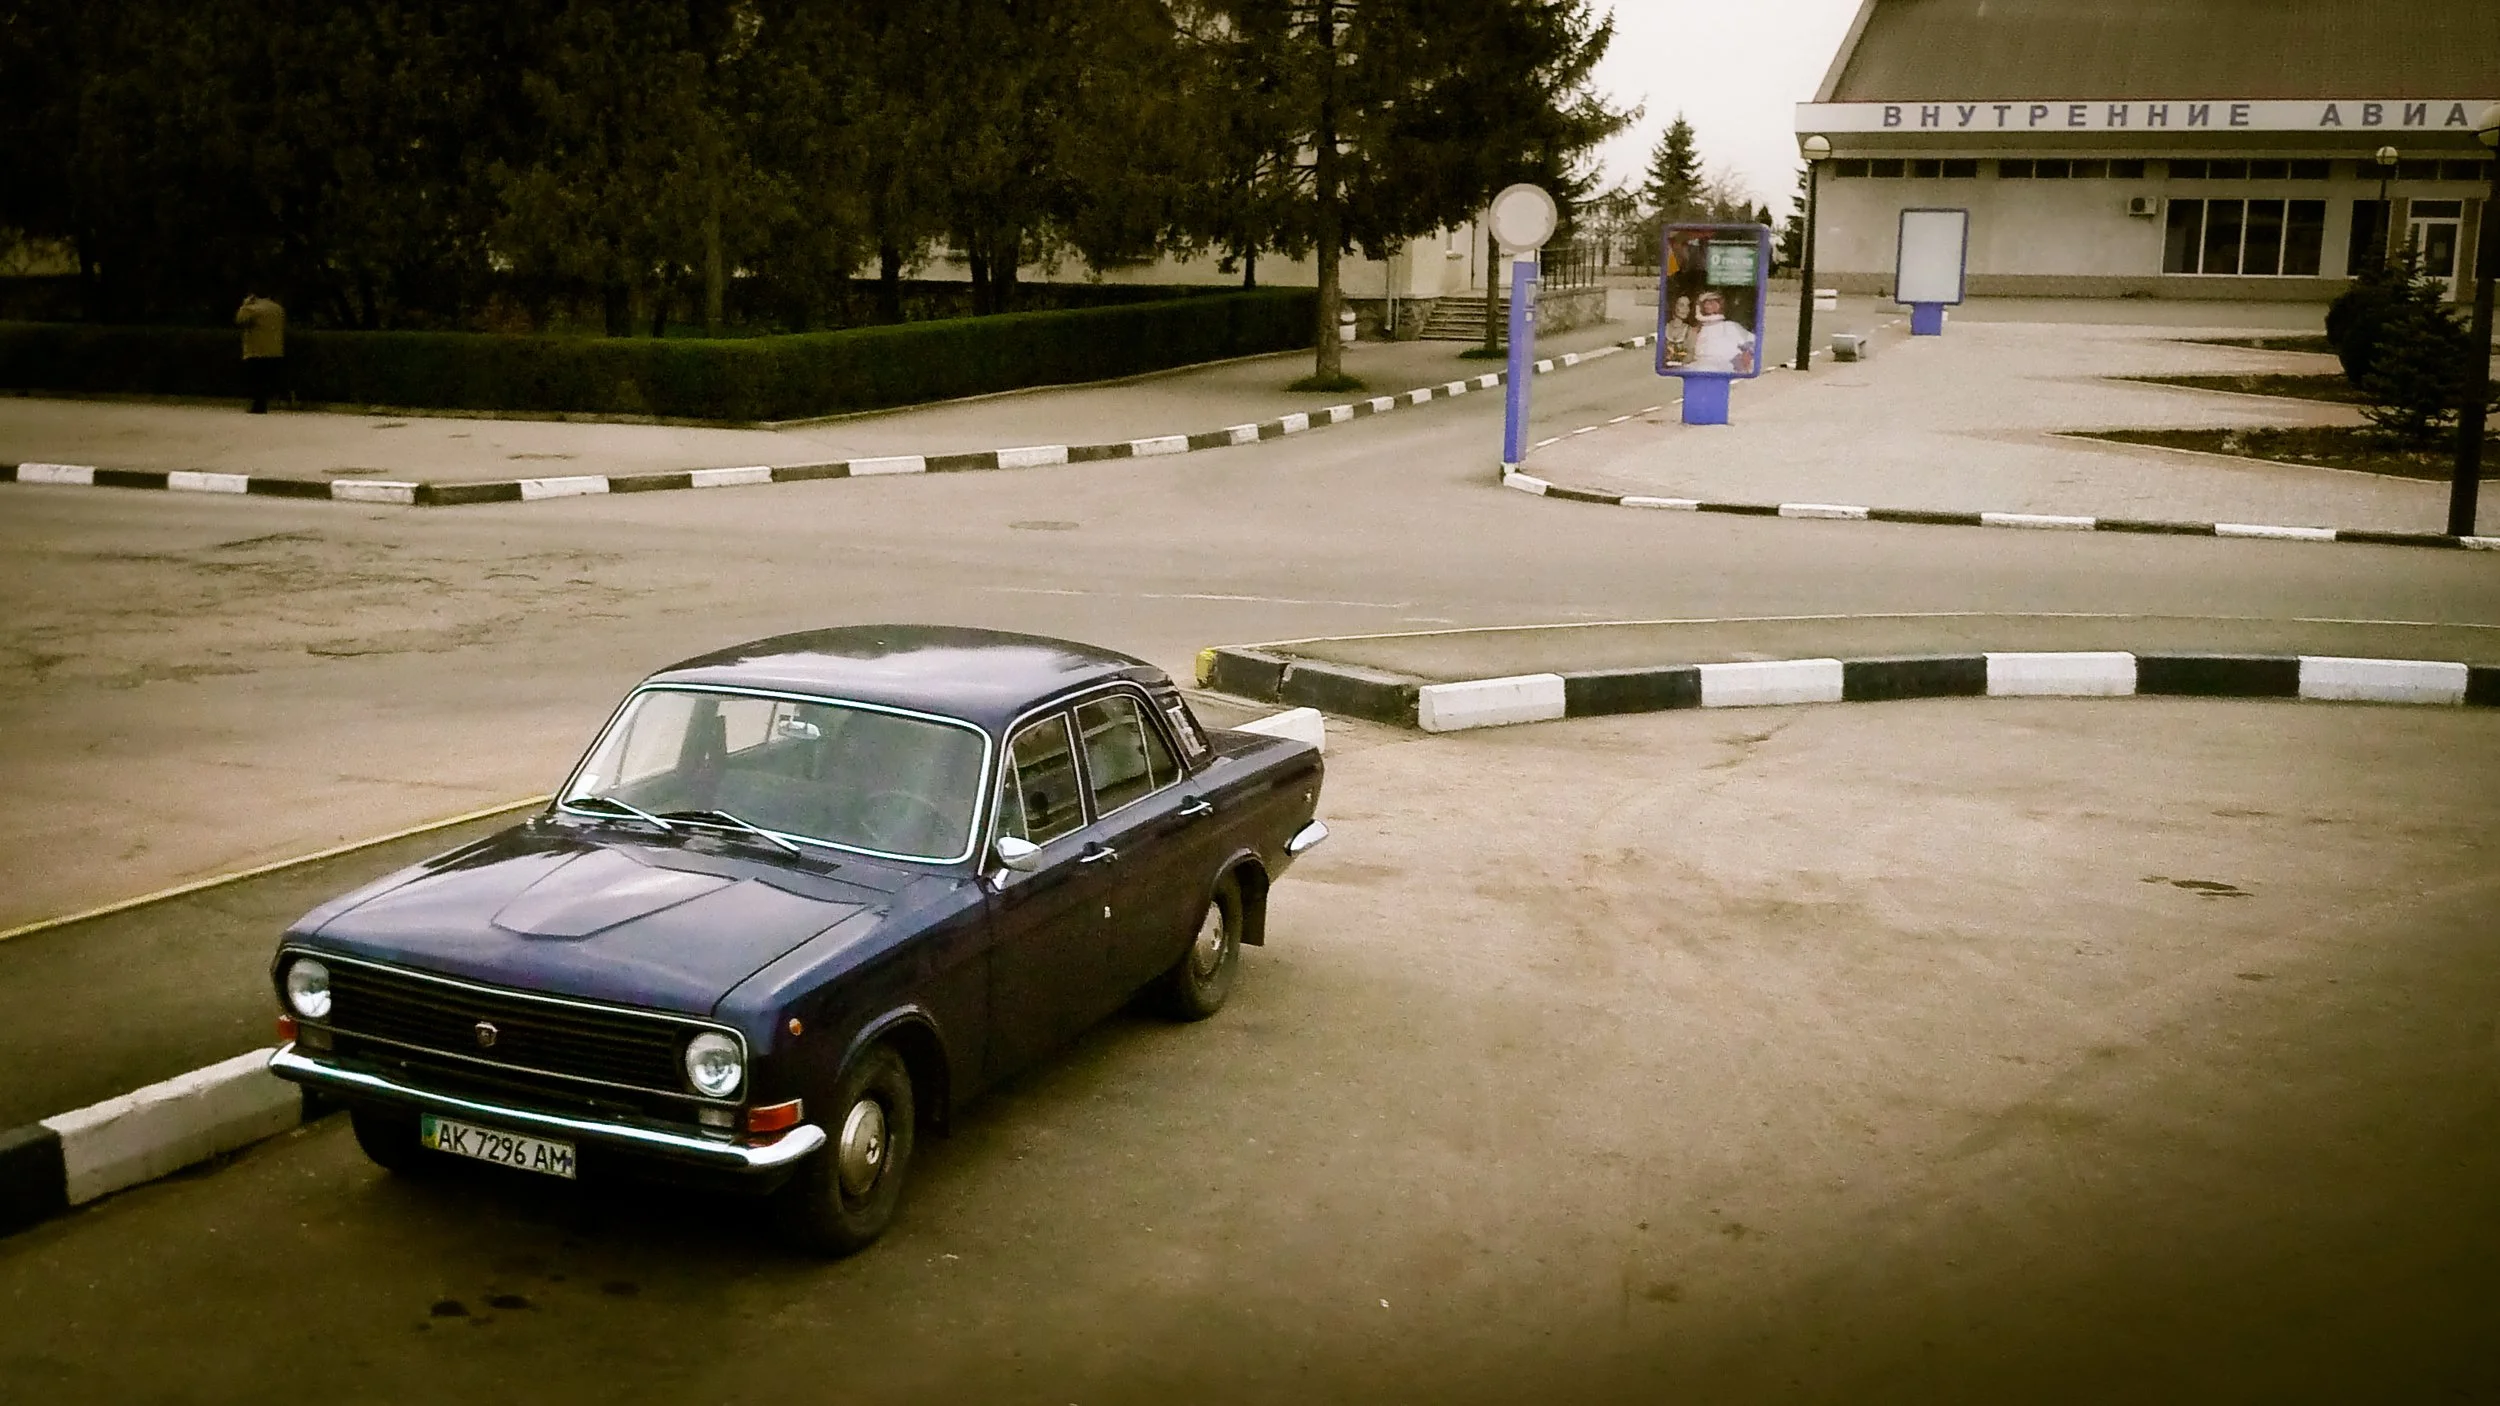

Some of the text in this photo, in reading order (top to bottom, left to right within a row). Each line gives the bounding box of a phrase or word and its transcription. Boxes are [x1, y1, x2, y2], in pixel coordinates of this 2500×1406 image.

[1883, 103, 2251, 128] ВНУТРЕННИЕ
[438, 1123, 567, 1174] AK 7296 AM
